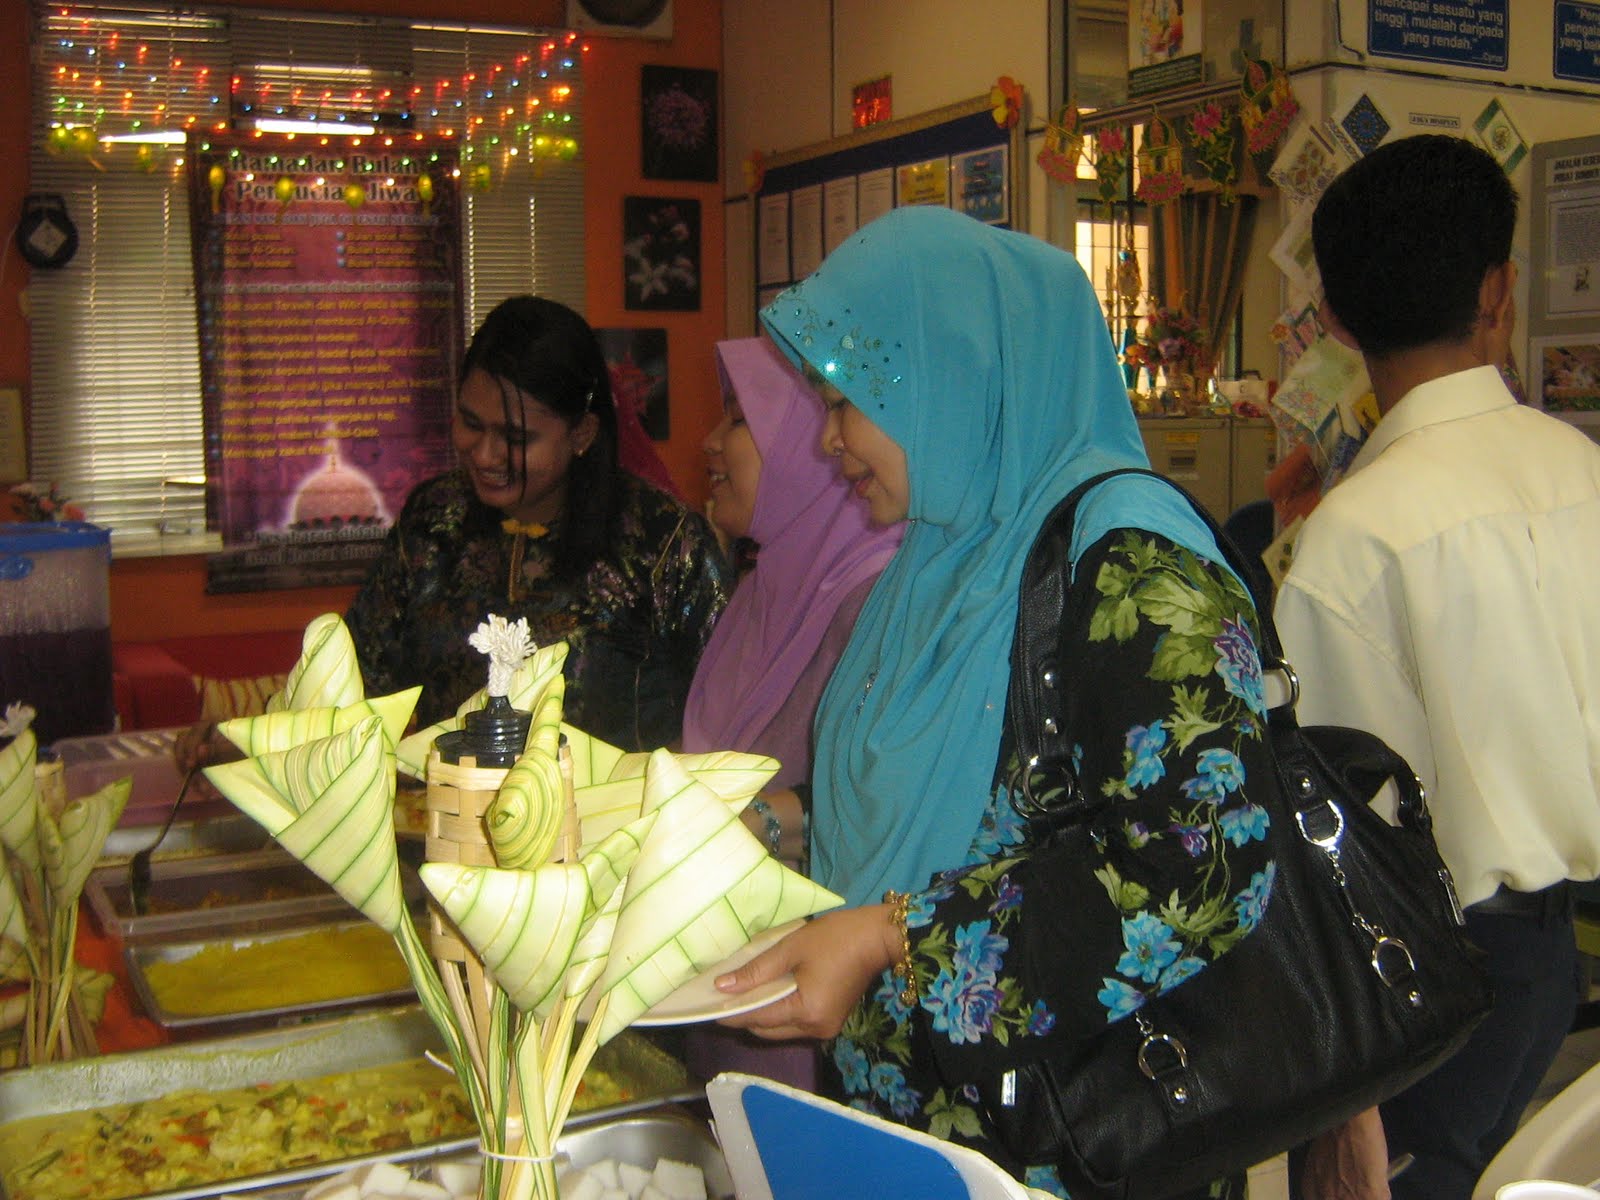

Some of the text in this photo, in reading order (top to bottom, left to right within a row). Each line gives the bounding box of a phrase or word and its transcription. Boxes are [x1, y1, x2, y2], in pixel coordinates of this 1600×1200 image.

[1375, 0, 1503, 25] mencapai sesuatu yang
[1374, 10, 1504, 39] tinggi, mulailah daripada
[1402, 32, 1430, 50] yang
[1559, 37, 1583, 51] yang
[231, 153, 420, 175] Ramadan Bulan
[367, 181, 418, 202] Jiwa
[369, 394, 398, 405] bulan
